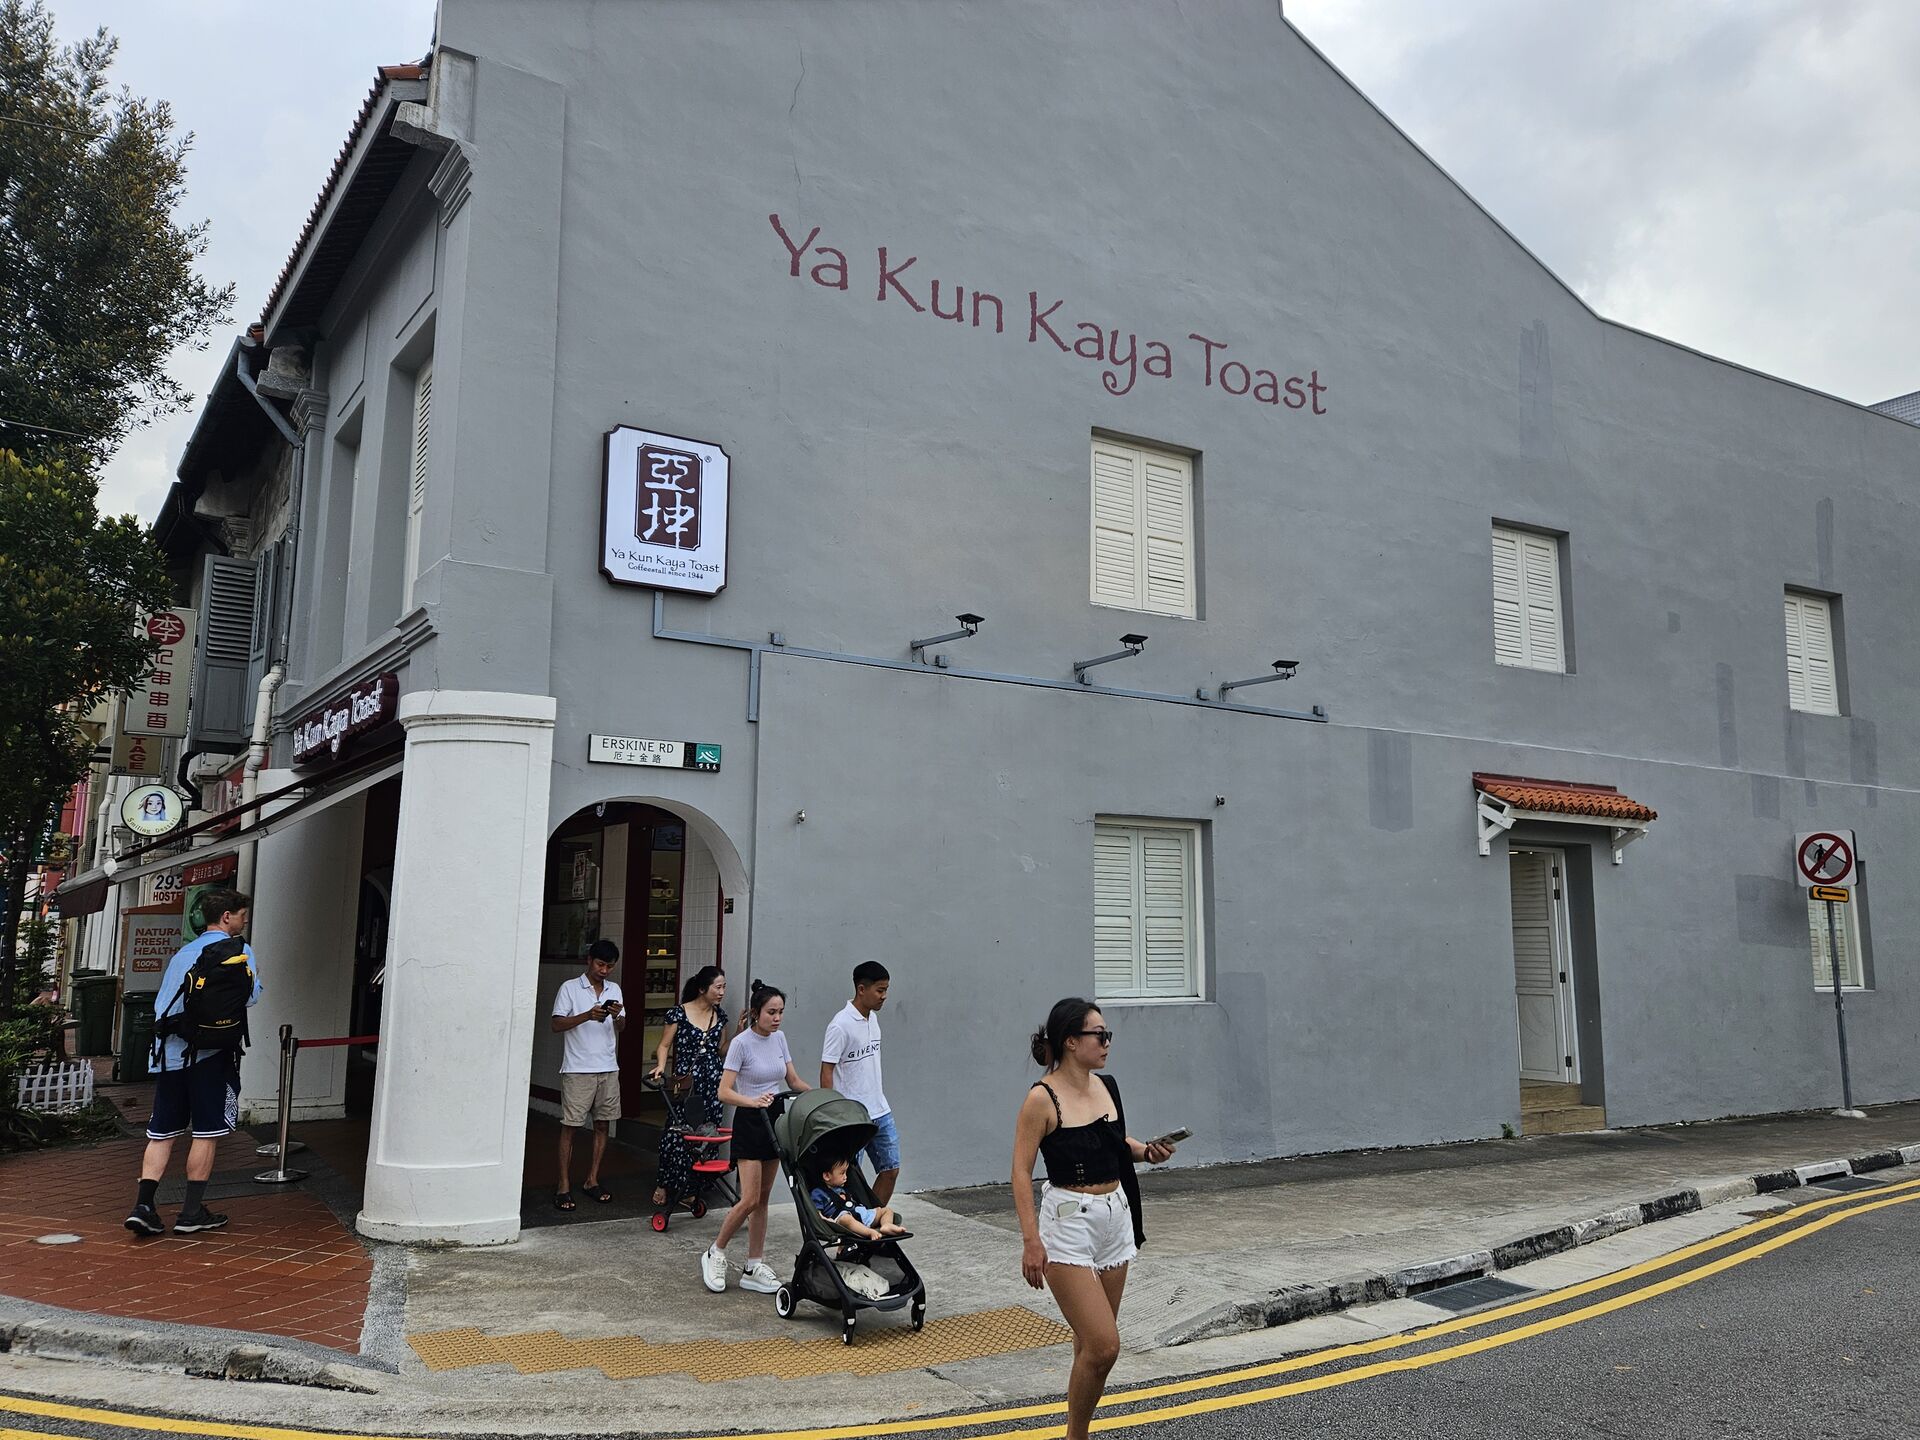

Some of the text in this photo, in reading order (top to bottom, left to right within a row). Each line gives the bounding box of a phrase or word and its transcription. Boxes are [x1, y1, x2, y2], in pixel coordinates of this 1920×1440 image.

[769, 213, 1327, 415] Ya Kun Kaya Toast
[611, 547, 720, 573] Ya Kun Kaya Toast
[627, 562, 704, 580] Coffeestall since 1944
[350, 679, 383, 725] Toast
[602, 738, 674, 754] ERSKINE RD
[154, 875, 183, 890] 293
[134, 937, 170, 946] FRESH
[135, 960, 159, 968] 100%
